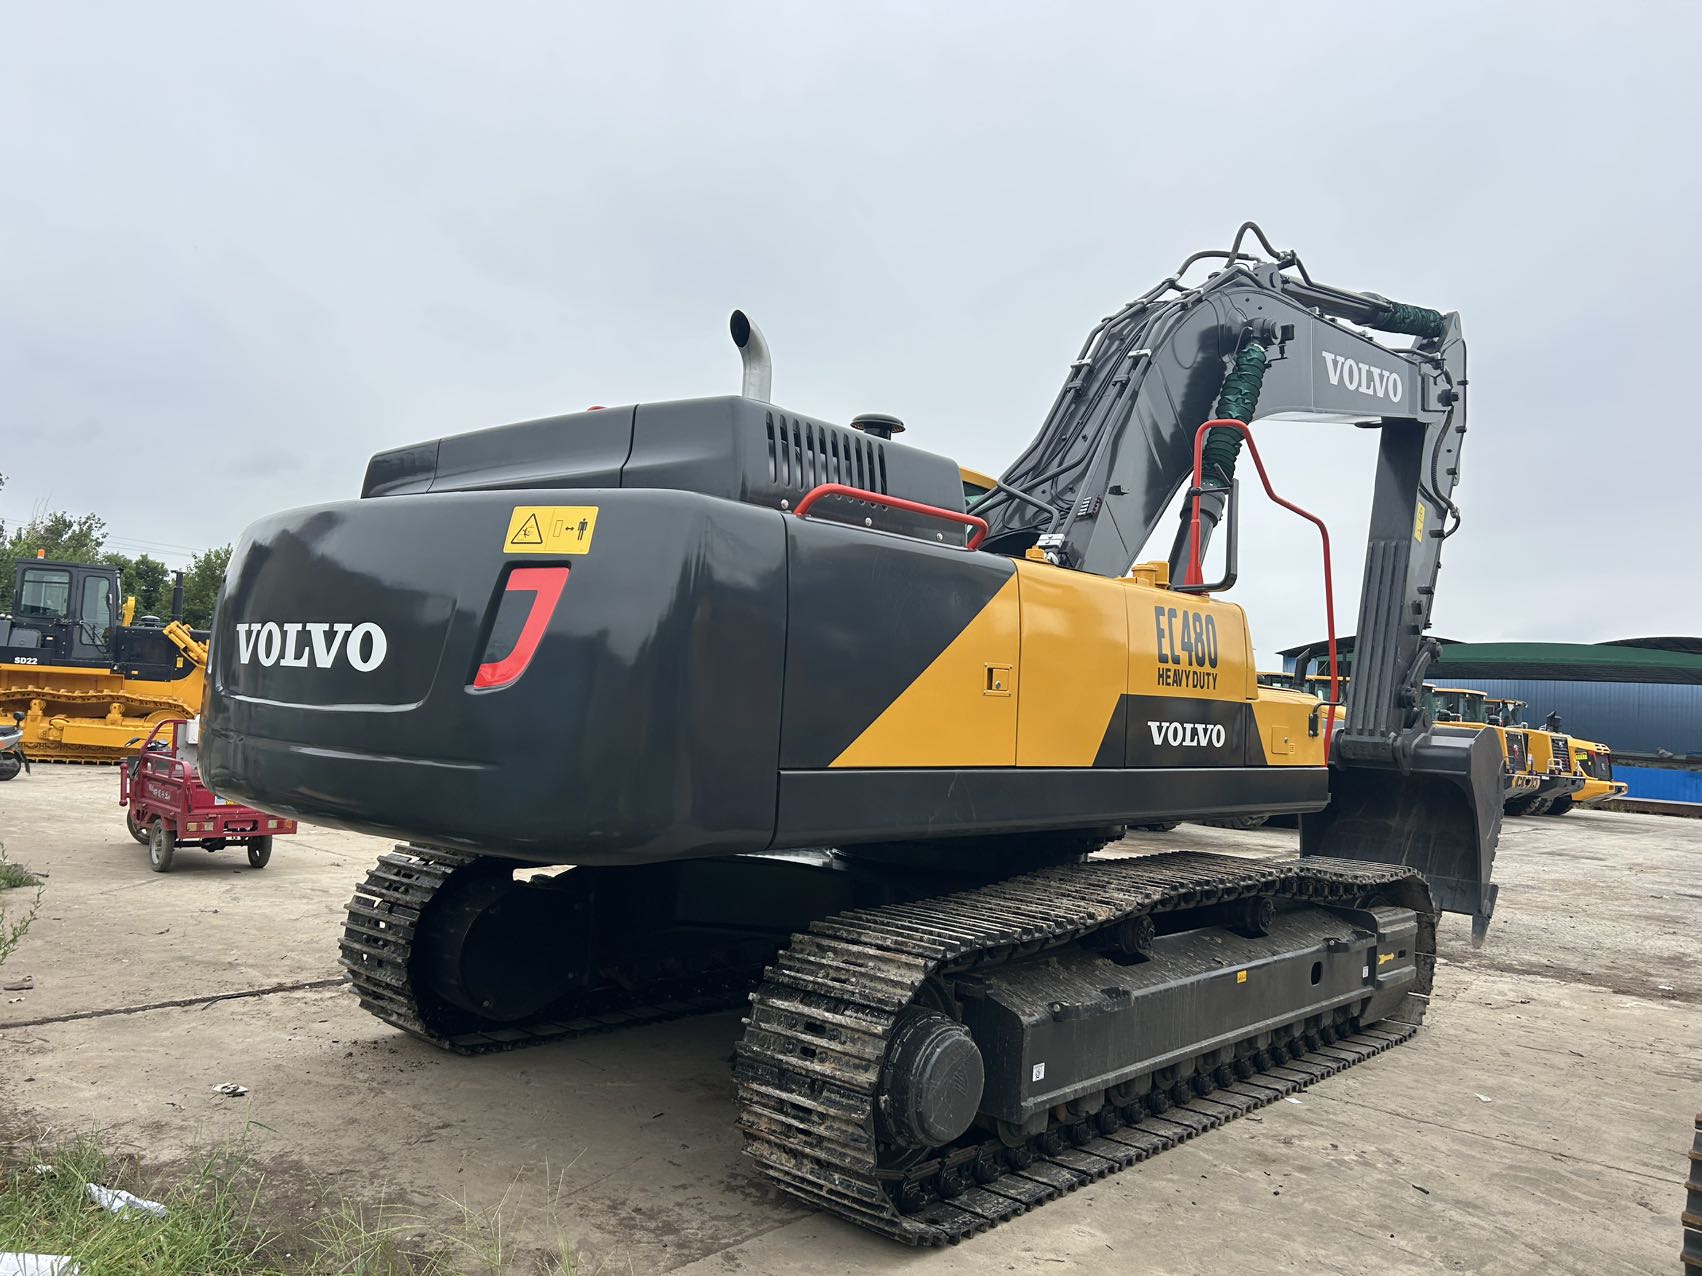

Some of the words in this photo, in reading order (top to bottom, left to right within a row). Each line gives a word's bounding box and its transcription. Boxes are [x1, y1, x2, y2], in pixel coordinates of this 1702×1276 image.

[1322, 351, 1402, 403] VOLVO
[236, 621, 388, 673] VOLVO
[1154, 605, 1219, 669] EC480
[14, 656, 38, 665] SD22
[1157, 667, 1190, 686] HEAVY
[1192, 672, 1219, 691] DUTY
[1147, 721, 1226, 748] VOLVO
